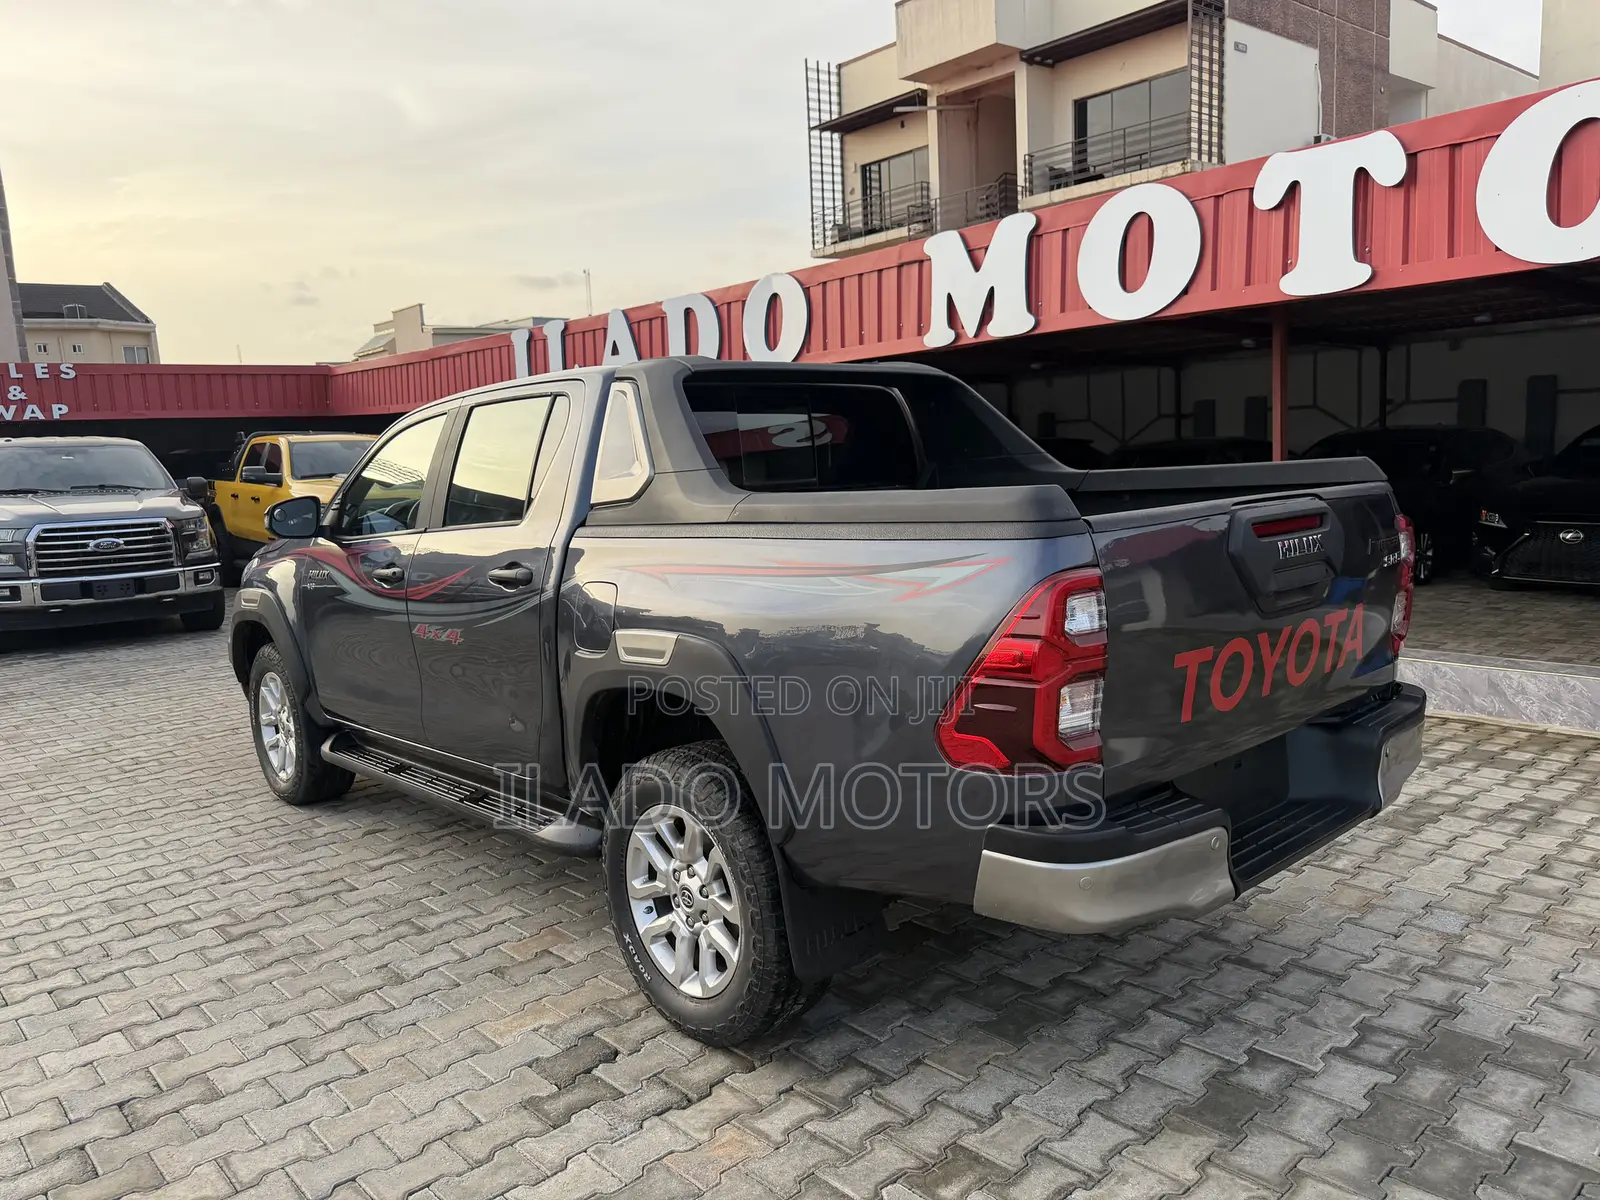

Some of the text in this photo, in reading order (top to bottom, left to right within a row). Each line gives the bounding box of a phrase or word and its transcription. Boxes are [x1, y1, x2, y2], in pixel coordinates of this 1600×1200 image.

[510, 272, 809, 378] ILADO
[8, 362, 76, 379] LES
[7, 385, 28, 400] &
[1277, 534, 1325, 560] HILUX
[1174, 603, 1364, 724] TOYOTA
